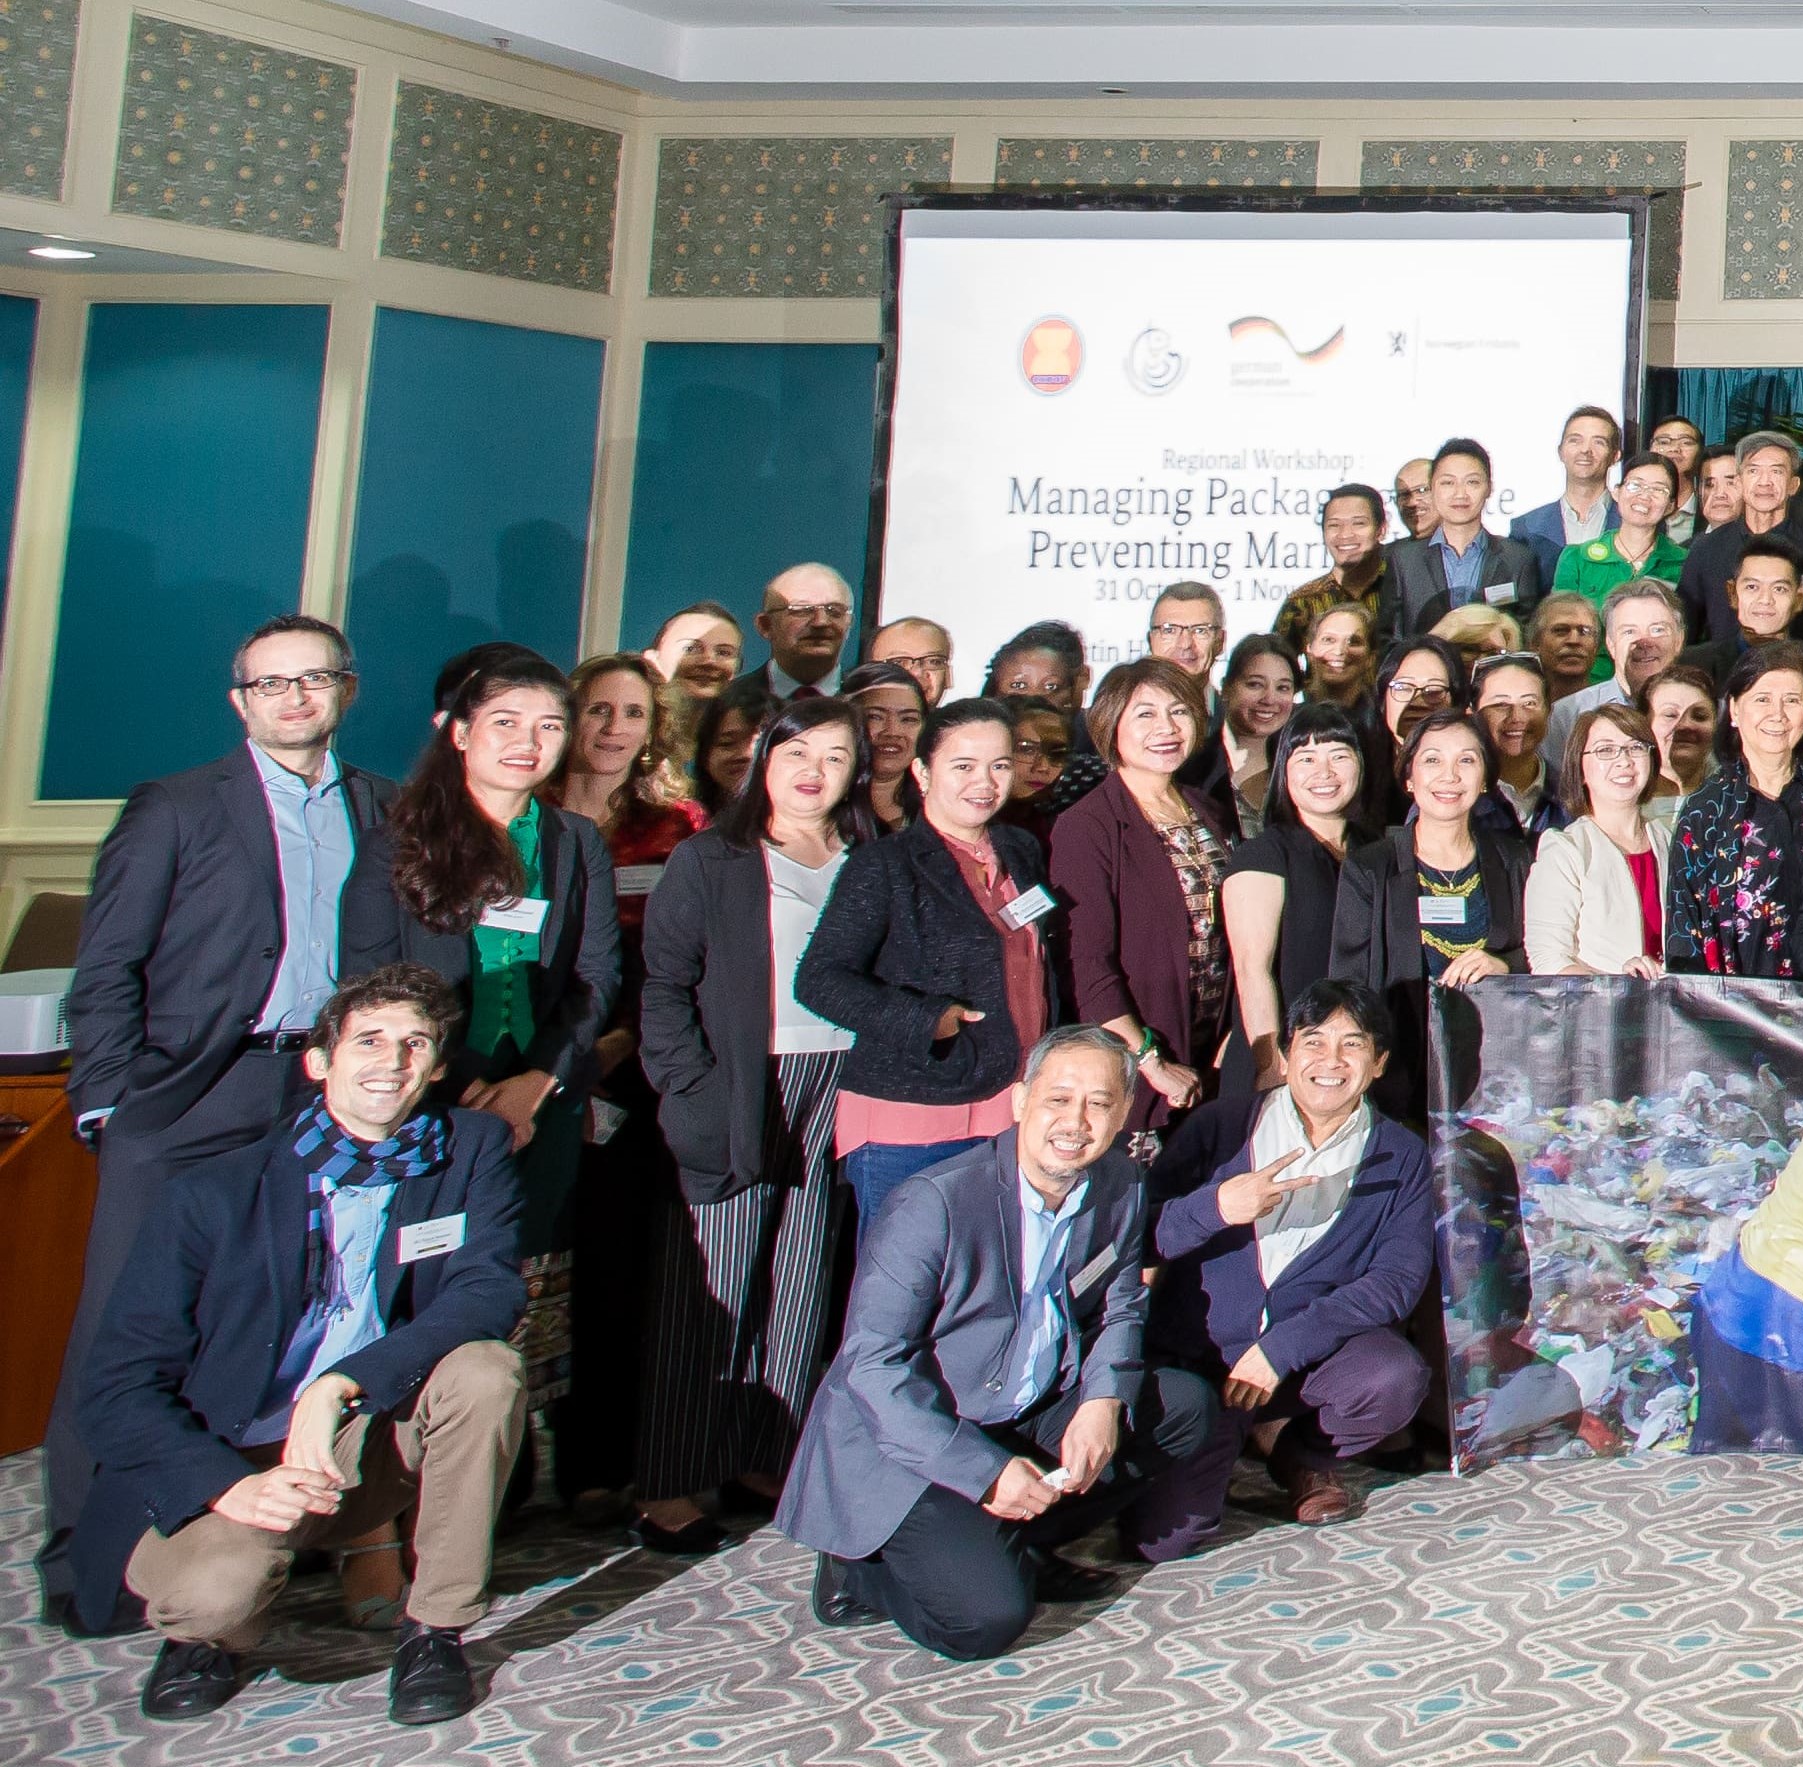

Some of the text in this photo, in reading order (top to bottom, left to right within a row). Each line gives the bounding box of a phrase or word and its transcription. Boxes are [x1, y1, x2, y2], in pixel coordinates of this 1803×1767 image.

[1163, 449, 1247, 473] Regional
[1253, 448, 1354, 474] Workshop
[1008, 477, 1192, 526] Managing
[1029, 530, 1231, 579] Preventing
[1096, 579, 1117, 600] 31
